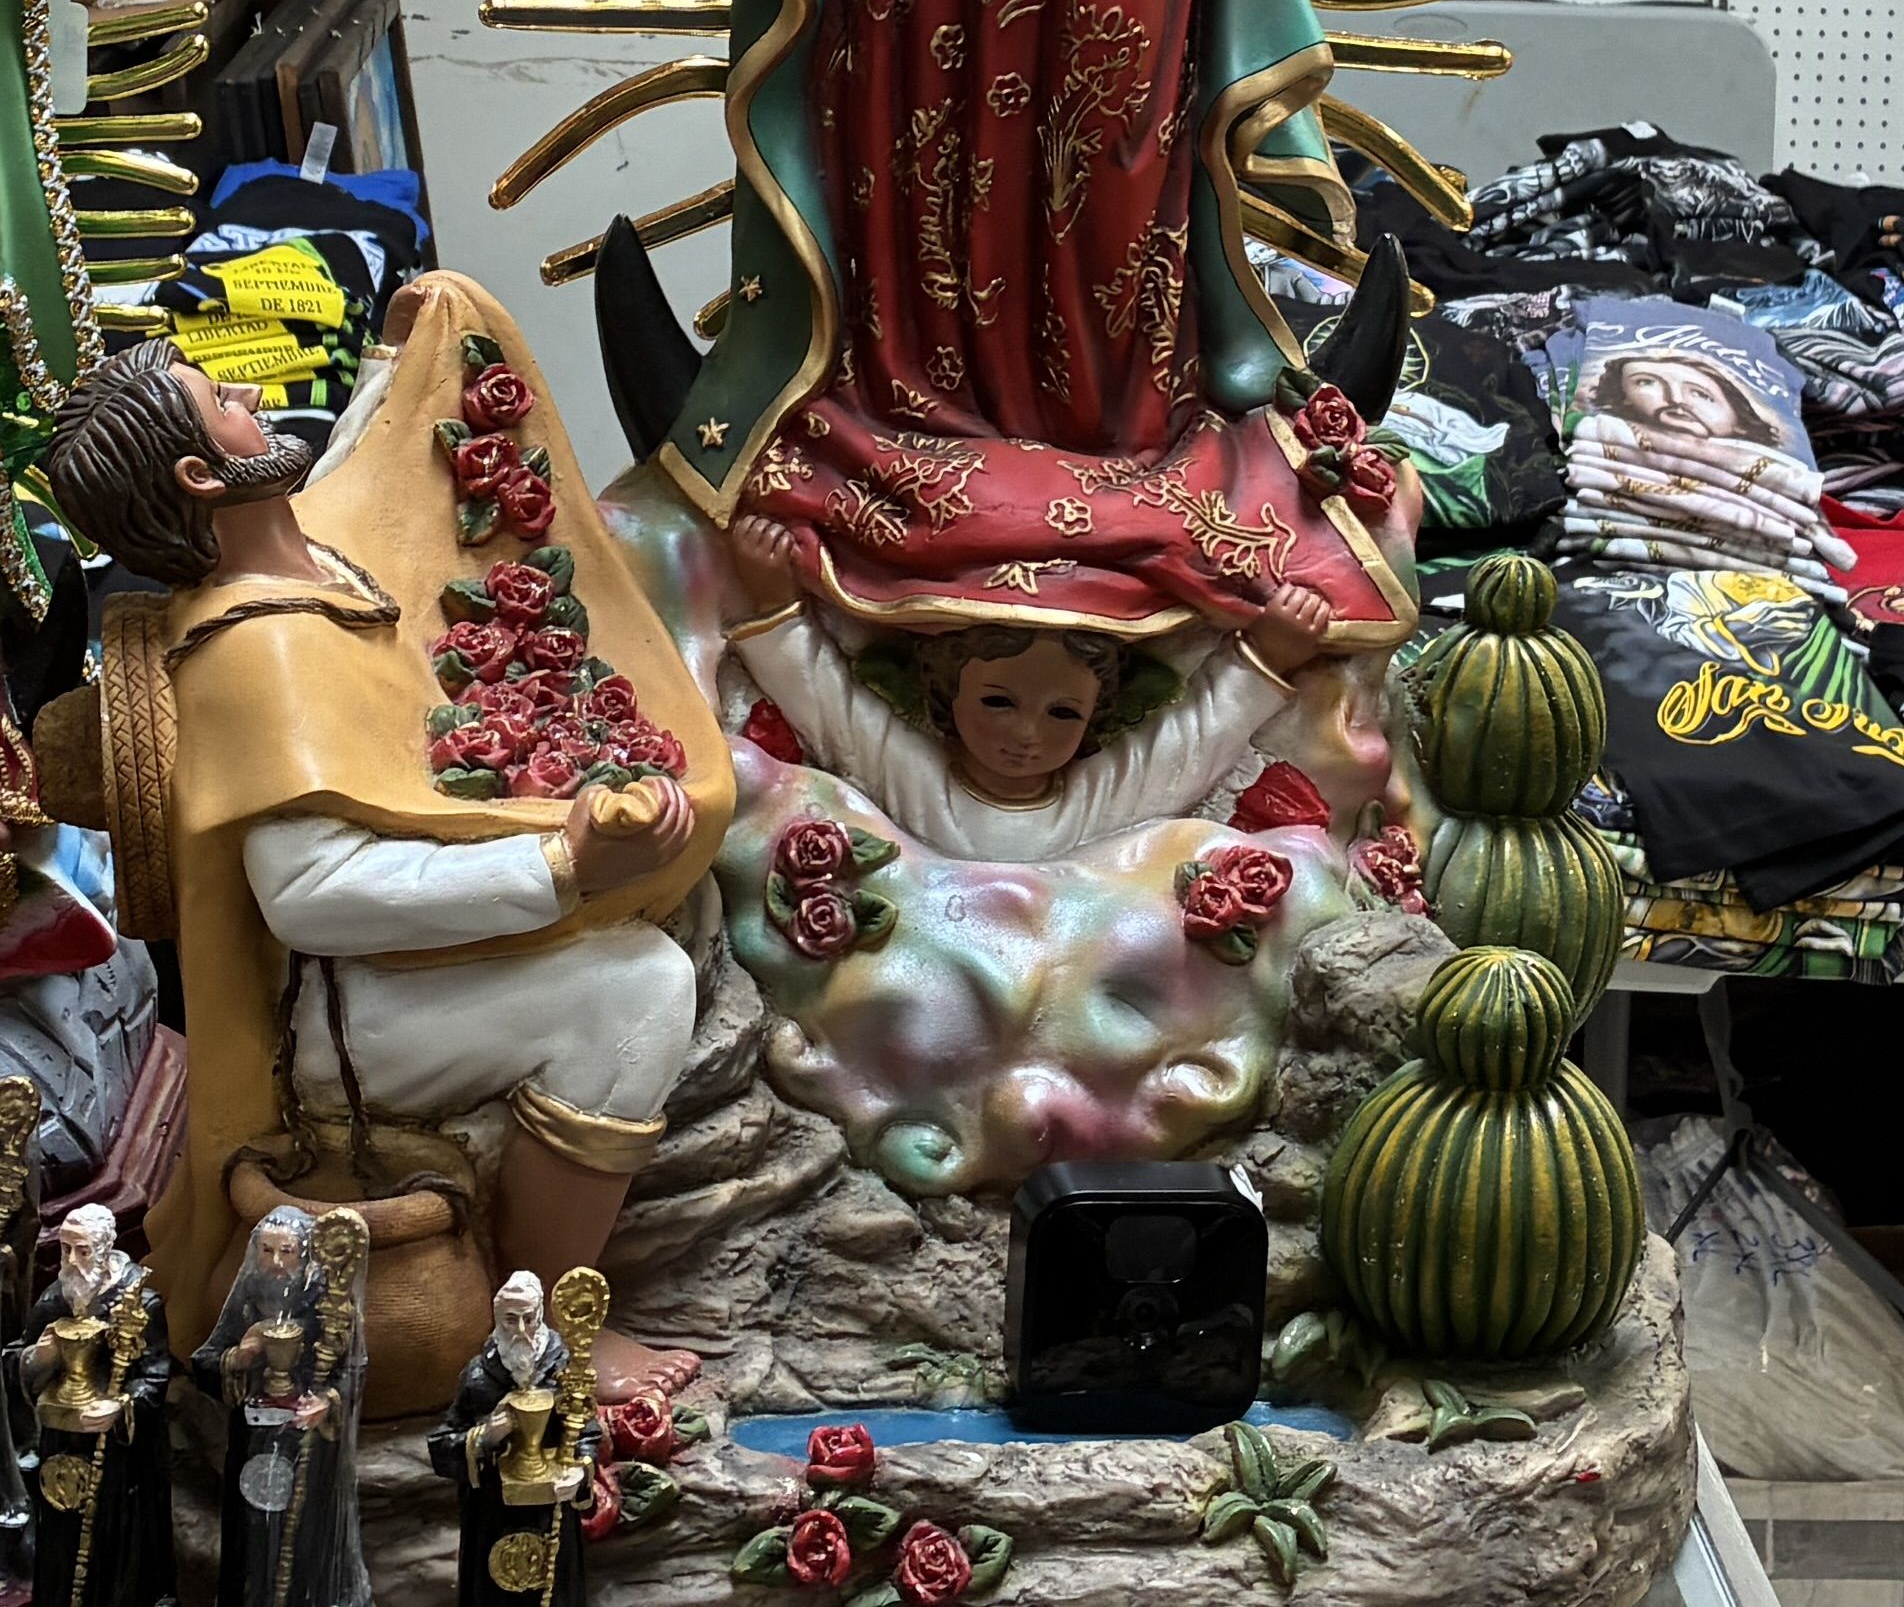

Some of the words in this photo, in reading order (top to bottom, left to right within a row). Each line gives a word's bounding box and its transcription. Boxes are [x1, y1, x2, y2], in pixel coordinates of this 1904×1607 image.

[260, 297, 284, 312] DE
[289, 298, 323, 314] 1821
[187, 320, 269, 344] LIBERTAD
[1656, 660, 1808, 745] San
